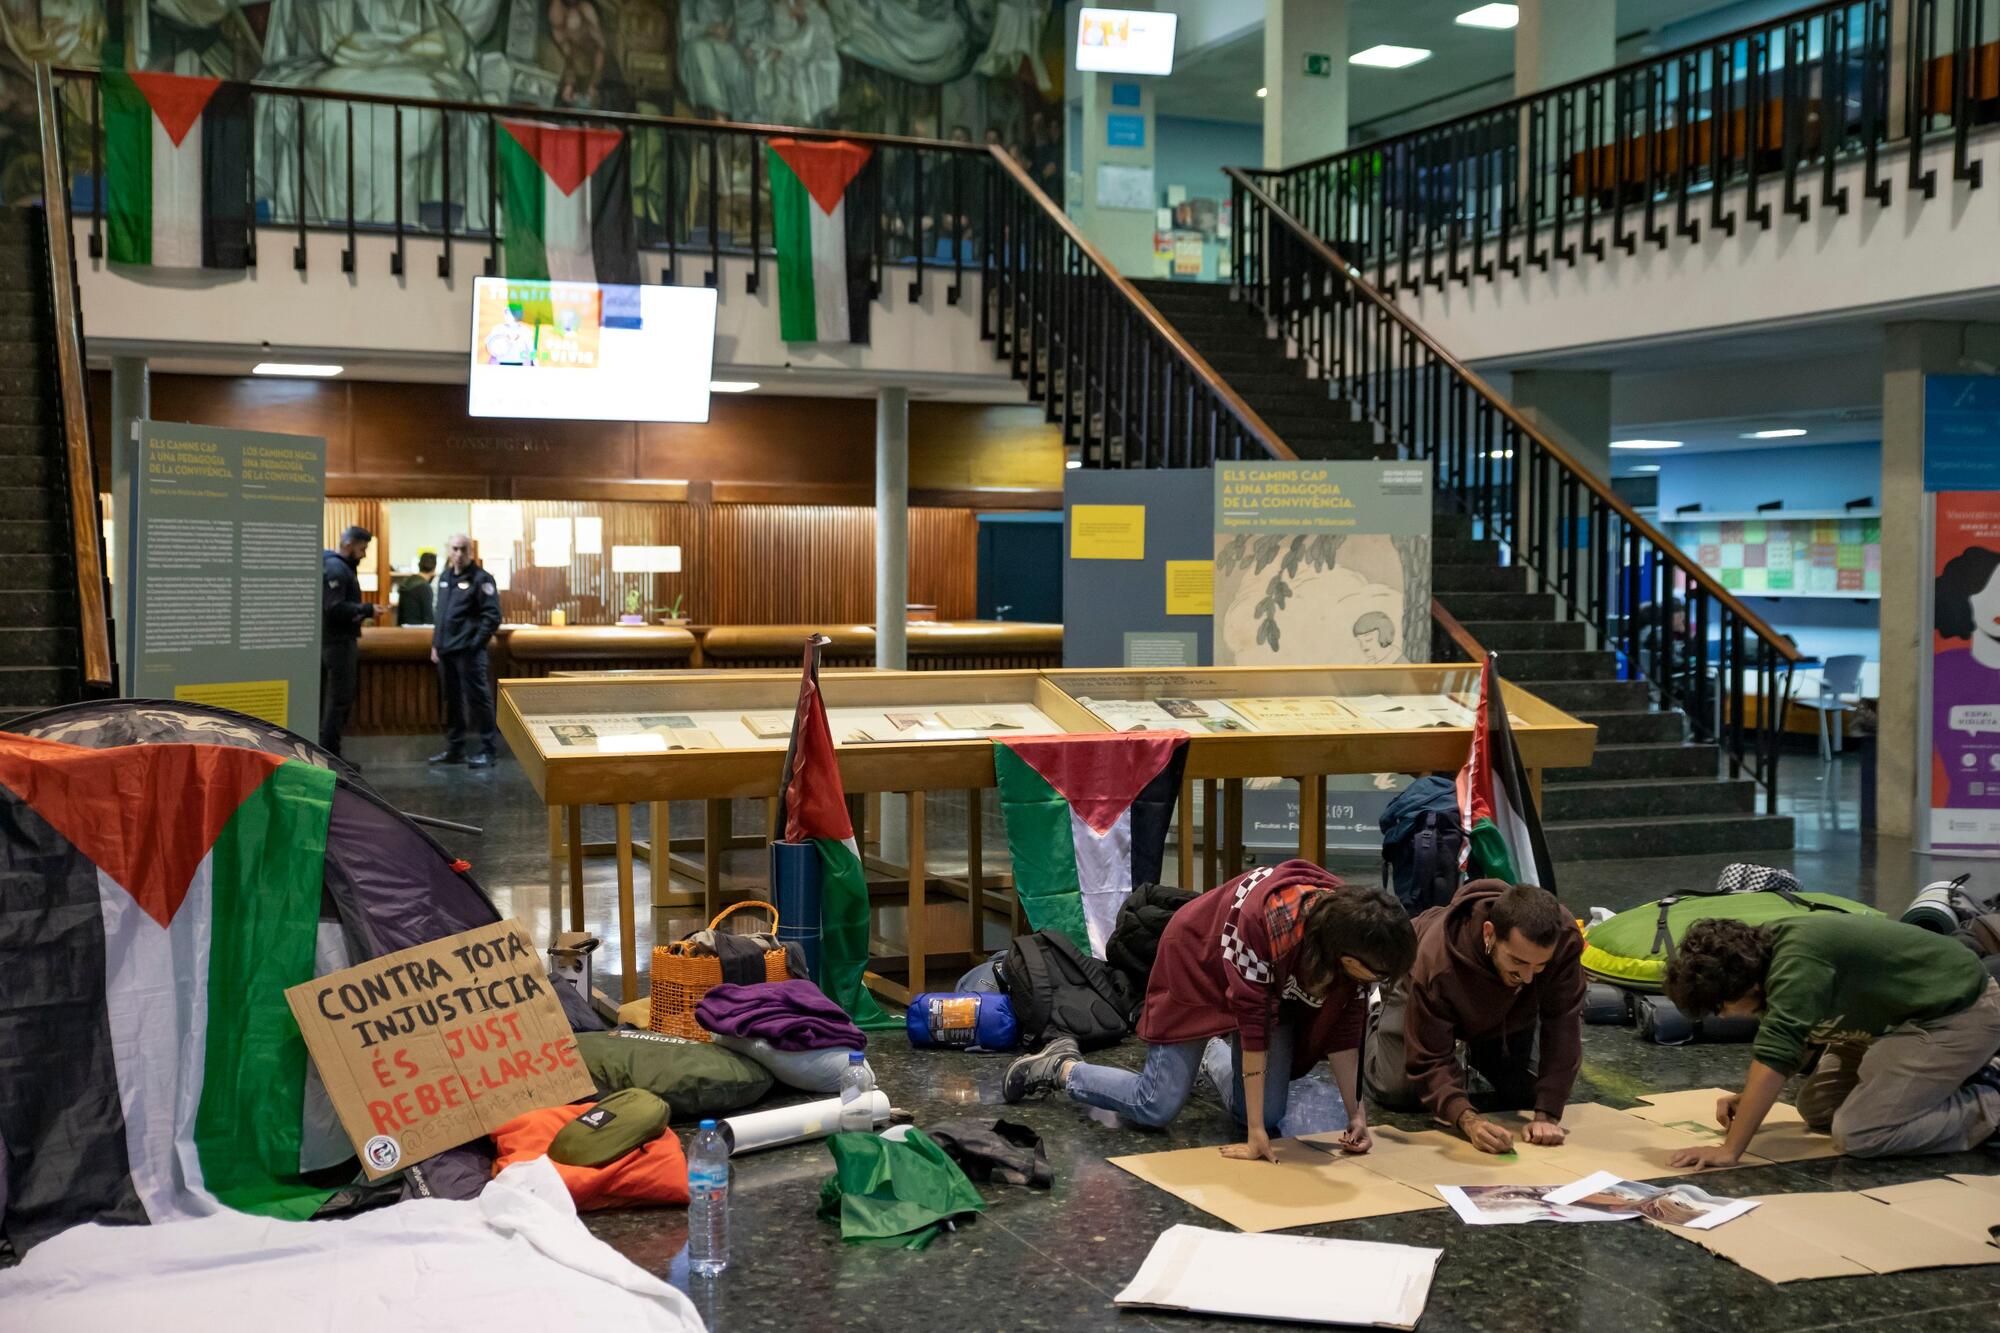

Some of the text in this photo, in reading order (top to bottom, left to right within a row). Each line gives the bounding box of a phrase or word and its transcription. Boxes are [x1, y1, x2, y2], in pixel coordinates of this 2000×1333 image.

[1223, 470, 1328, 481] ELS CAMINS CAP
[1223, 484, 1341, 495] A UNA PEDAGOGIA
[1223, 497, 1240, 508] DE
[1243, 497, 1258, 508] LA
[317, 931, 530, 1021] CONTRA TOTA
[351, 973, 546, 1049] INJUSTÍCIA
[370, 1012, 524, 1088] ÉS JUST
